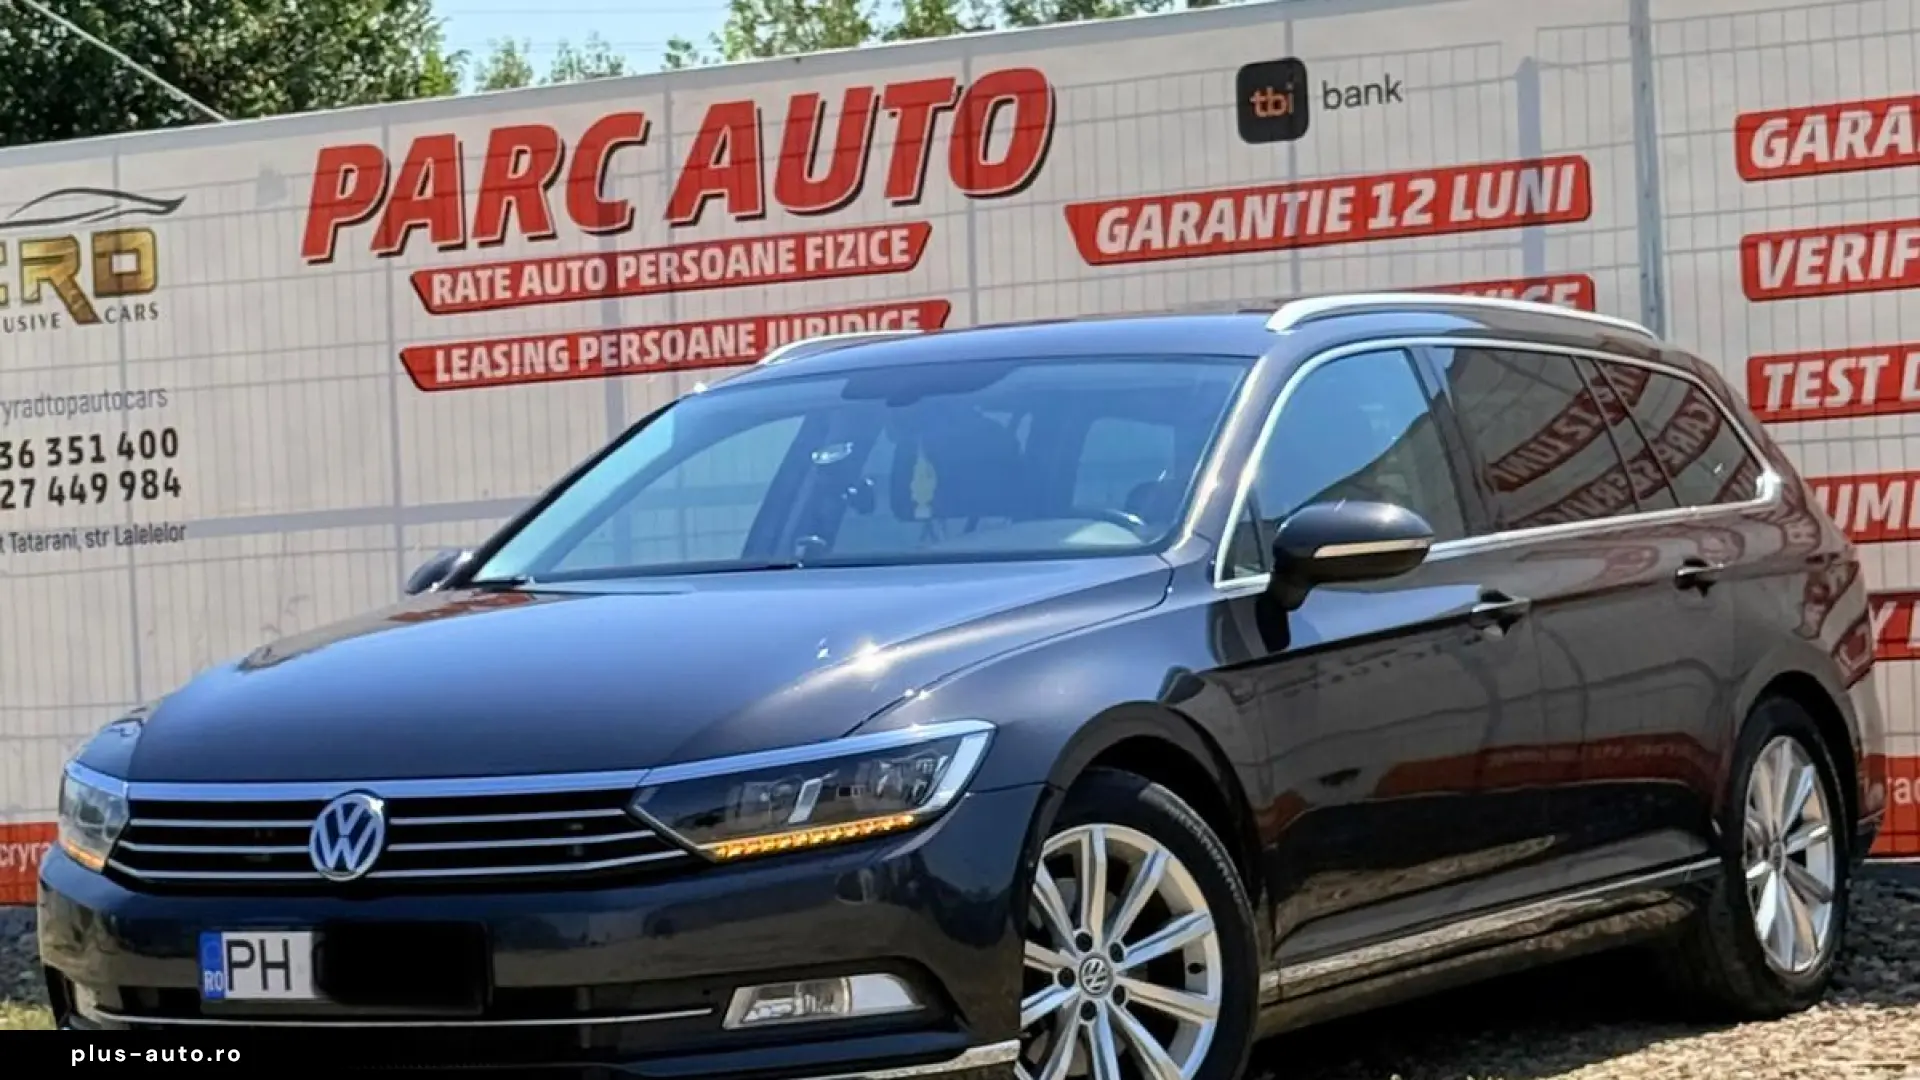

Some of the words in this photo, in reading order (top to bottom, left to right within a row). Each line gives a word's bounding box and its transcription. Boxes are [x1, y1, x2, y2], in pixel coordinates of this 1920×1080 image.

[1250, 81, 1295, 119] tbi
[1323, 74, 1403, 111] bank
[301, 110, 652, 263] PARC
[665, 67, 1056, 225] AUTO
[1750, 104, 1920, 169] GARA
[1096, 186, 1356, 254] GARANTIE
[1367, 177, 1434, 230] 12
[1449, 163, 1575, 224] LUNI
[0, 228, 158, 325] RD
[431, 268, 512, 306] RATE
[519, 258, 608, 297] AUTO
[616, 239, 796, 288] PERSOANE
[805, 229, 911, 272] FIZICE
[1757, 227, 1920, 291] VERIF
[104, 302, 160, 324] CARS
[435, 338, 570, 384] LEASING
[578, 323, 757, 371] PERSOANE
[1762, 353, 1890, 413] TEST
[0, 387, 169, 427] yradtopautocars
[46, 434, 106, 467] 351
[117, 427, 179, 461] 400
[0, 478, 36, 510] 27
[47, 472, 108, 507] 449
[119, 467, 182, 502] 984
[84, 528, 109, 550] str
[204, 970, 225, 993] RO
[226, 938, 293, 993] PH
